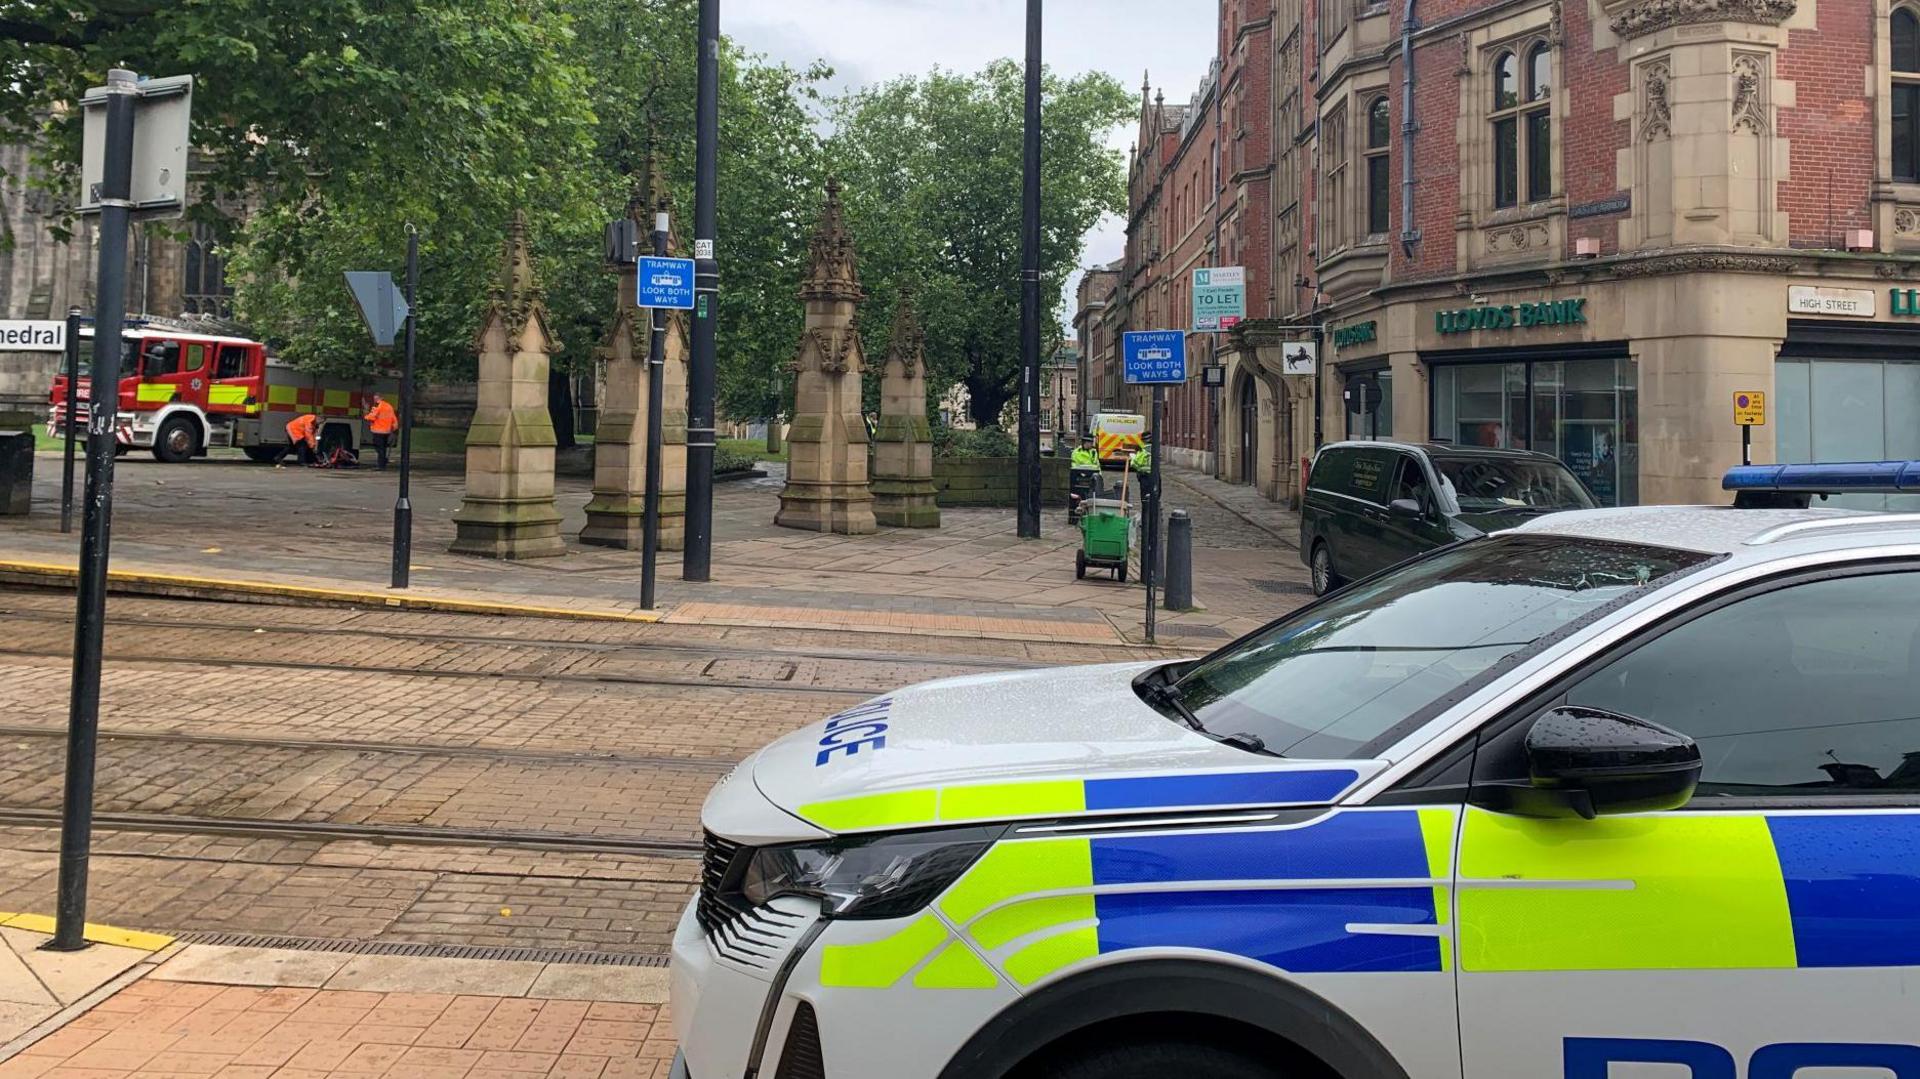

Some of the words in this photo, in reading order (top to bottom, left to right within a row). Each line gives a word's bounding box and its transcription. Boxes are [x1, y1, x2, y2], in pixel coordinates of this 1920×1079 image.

[695, 241, 711, 249] CAT
[646, 260, 688, 270] TRAMWAY
[642, 287, 665, 295] LOOK
[667, 288, 690, 296] BOTH
[655, 295, 678, 304] WAYS
[1198, 295, 1214, 304] TO
[1217, 294, 1240, 304] LET
[1800, 299, 1821, 308] HIGH
[1826, 299, 1859, 311] STREET
[1435, 304, 1514, 333] LLOYDS
[1519, 297, 1588, 327] BANK
[1131, 333, 1177, 342] TRAMWAY
[1128, 361, 1153, 370] LOOK
[1156, 361, 1181, 369] BOTH
[1142, 370, 1168, 378] WAYS
